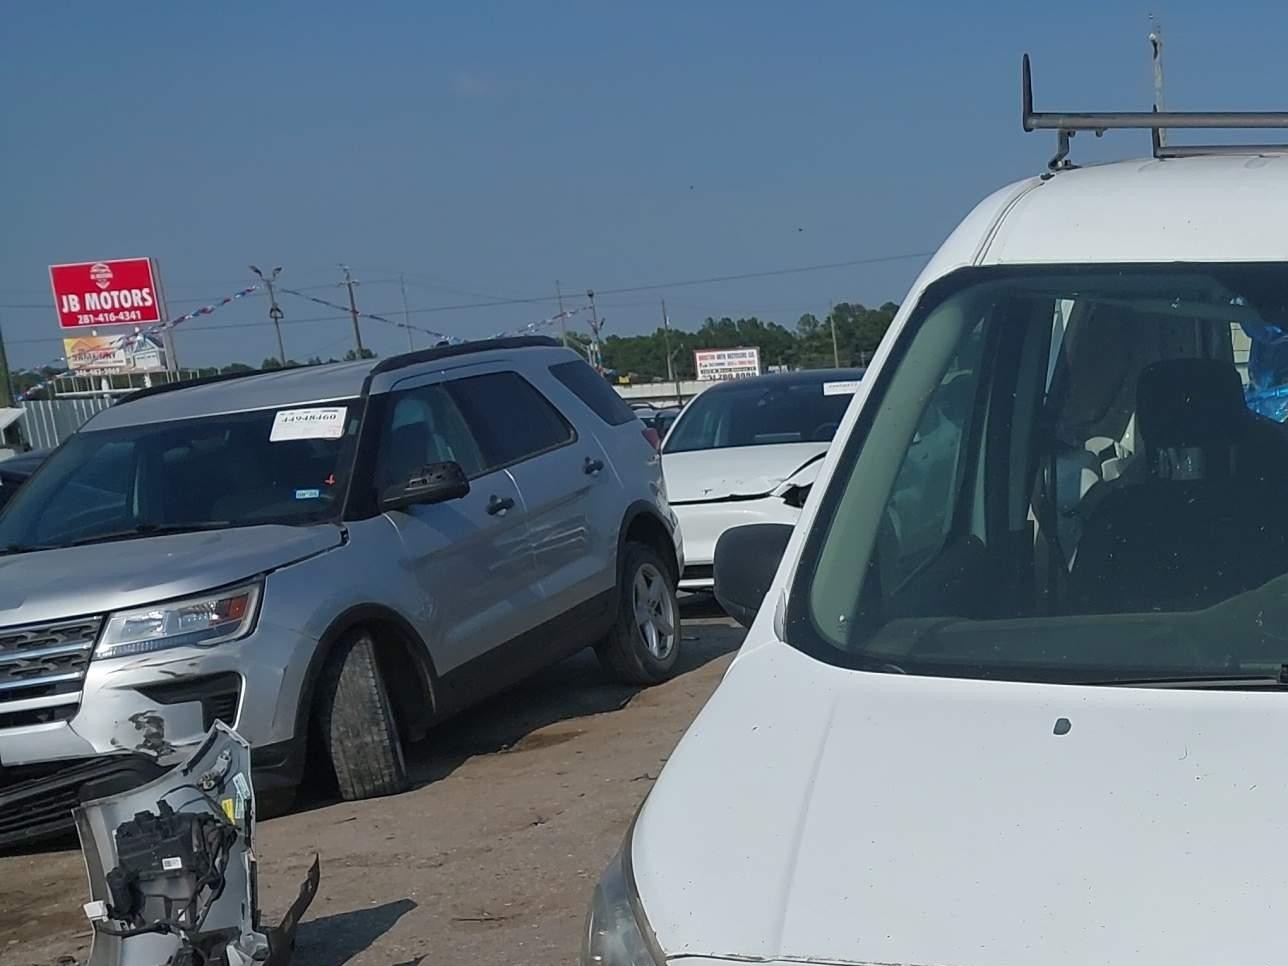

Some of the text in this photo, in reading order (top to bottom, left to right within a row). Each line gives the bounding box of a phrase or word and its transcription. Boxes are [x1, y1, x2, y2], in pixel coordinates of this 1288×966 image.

[61, 288, 153, 313] JB MOTORS
[77, 311, 142, 325] 281-416-4341
